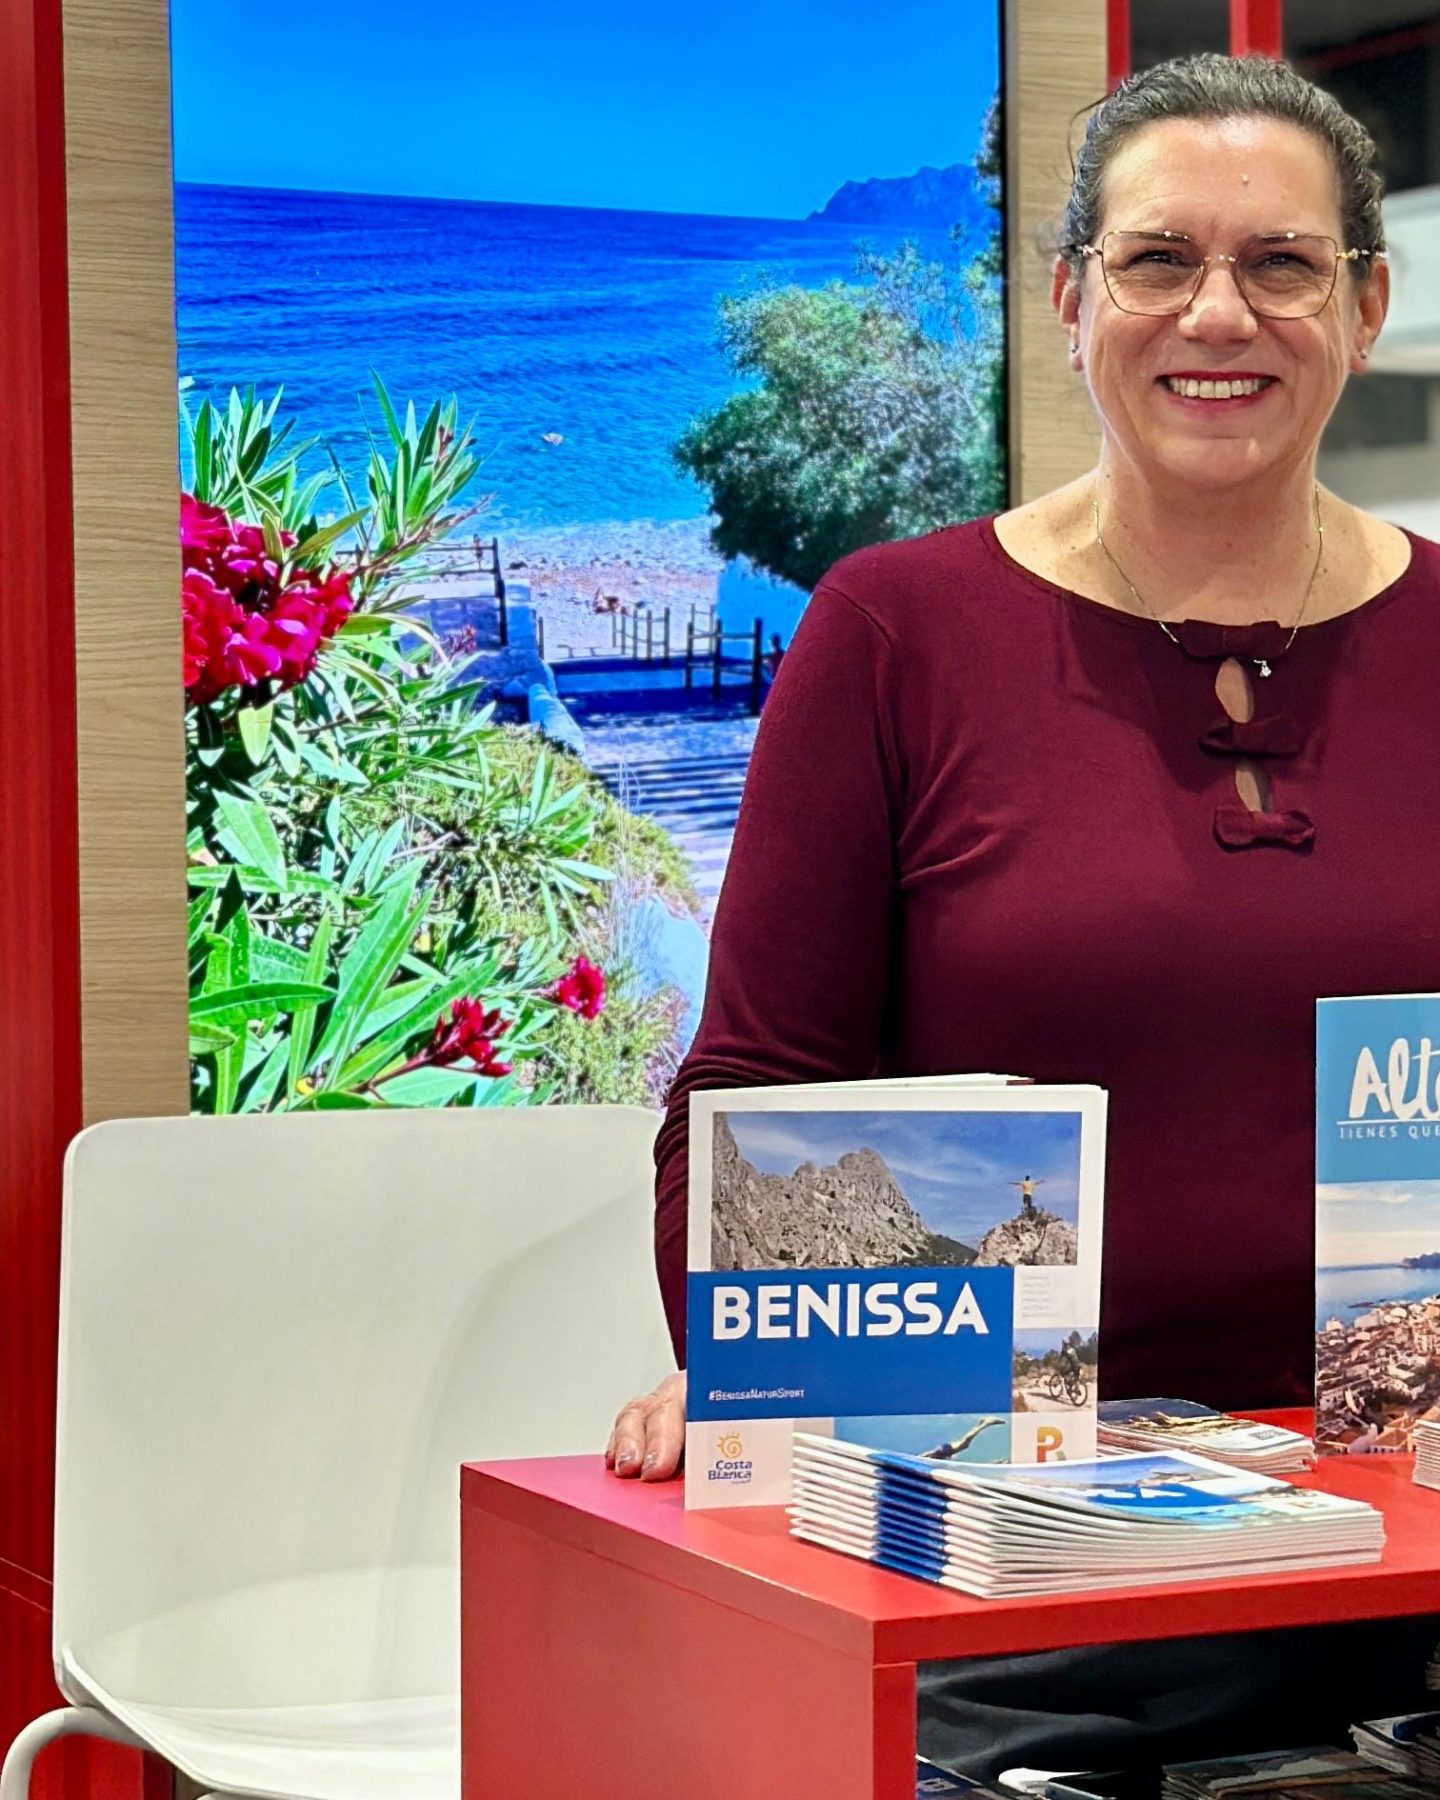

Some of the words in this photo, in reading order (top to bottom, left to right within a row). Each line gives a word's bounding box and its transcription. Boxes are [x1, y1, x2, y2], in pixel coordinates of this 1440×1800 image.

[1408, 1124, 1440, 1140] QUE
[712, 1281, 989, 1341] BENISSA
[715, 1459, 752, 1471] Costa
[708, 1469, 752, 1481] Blanca
